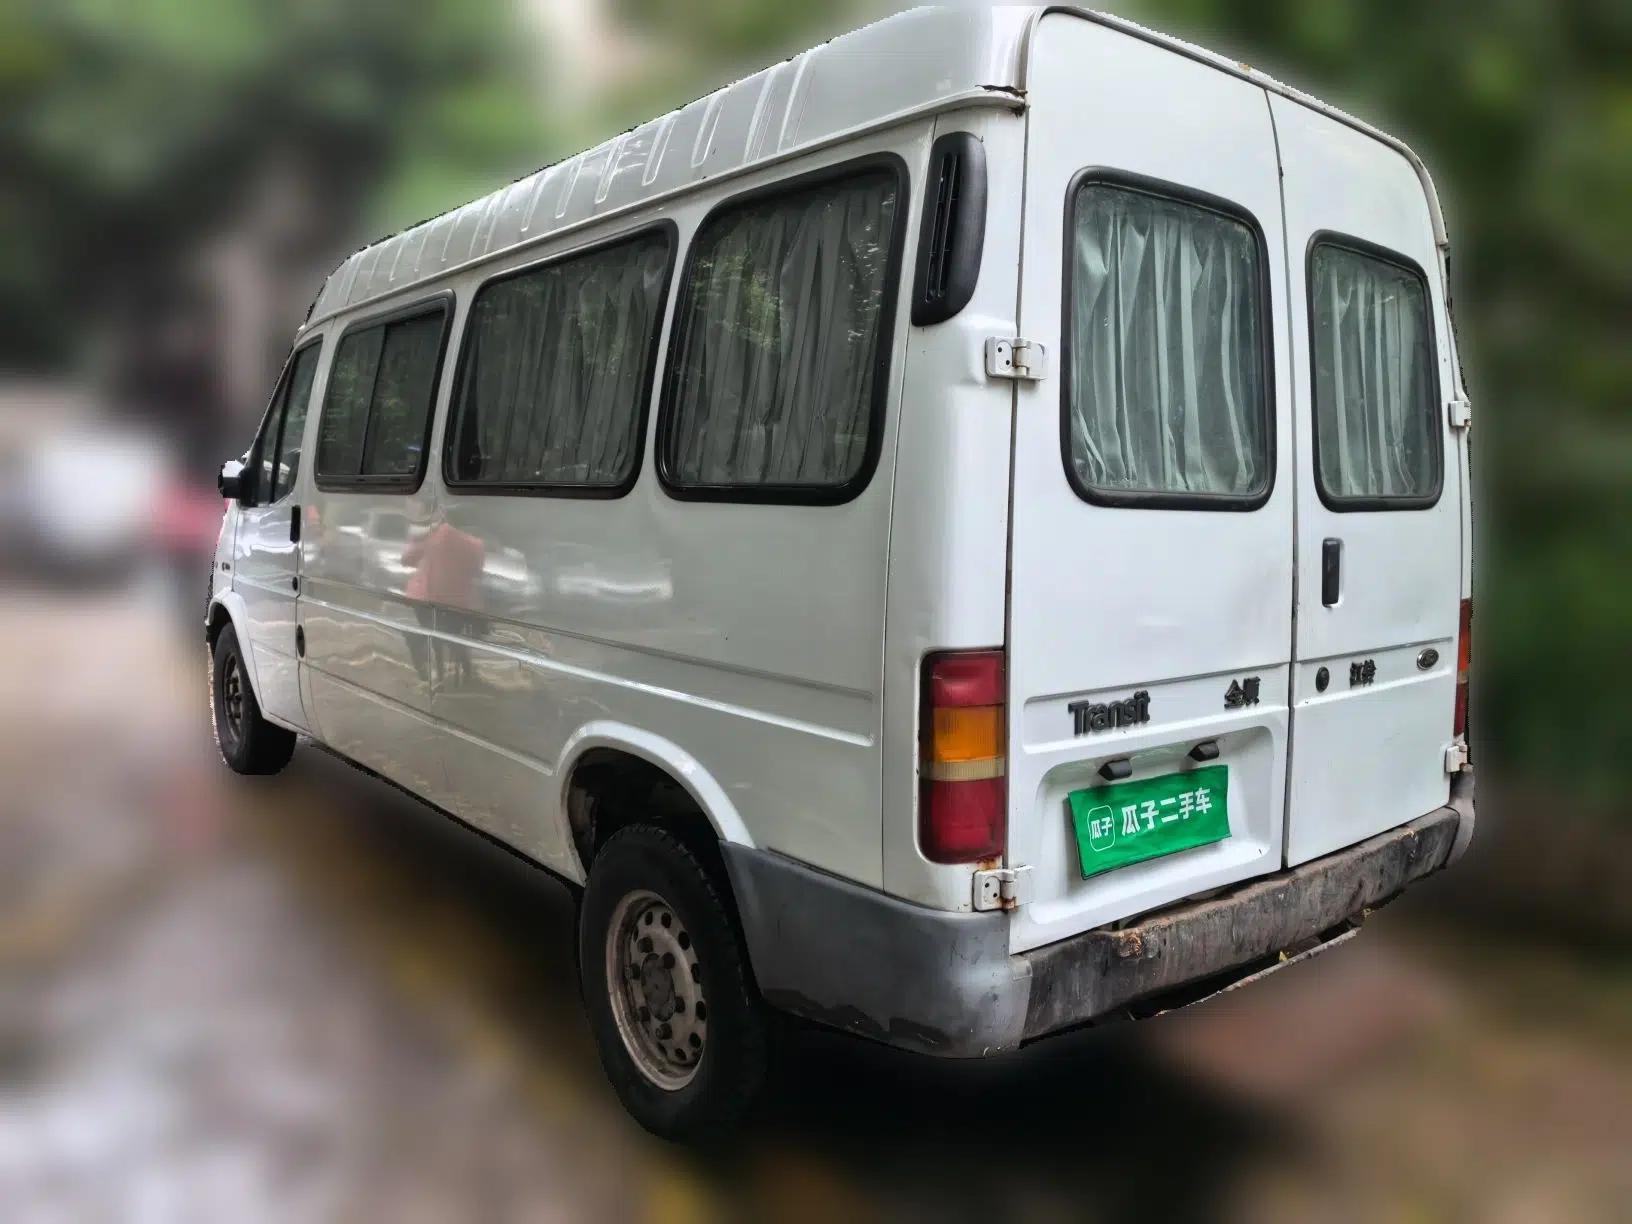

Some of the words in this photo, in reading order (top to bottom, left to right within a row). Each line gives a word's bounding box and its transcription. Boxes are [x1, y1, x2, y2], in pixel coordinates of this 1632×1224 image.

[1069, 691, 1151, 736] Transit
[1091, 816, 1113, 840] 瓜子
[1121, 787, 1212, 836] 瓜子二手车
